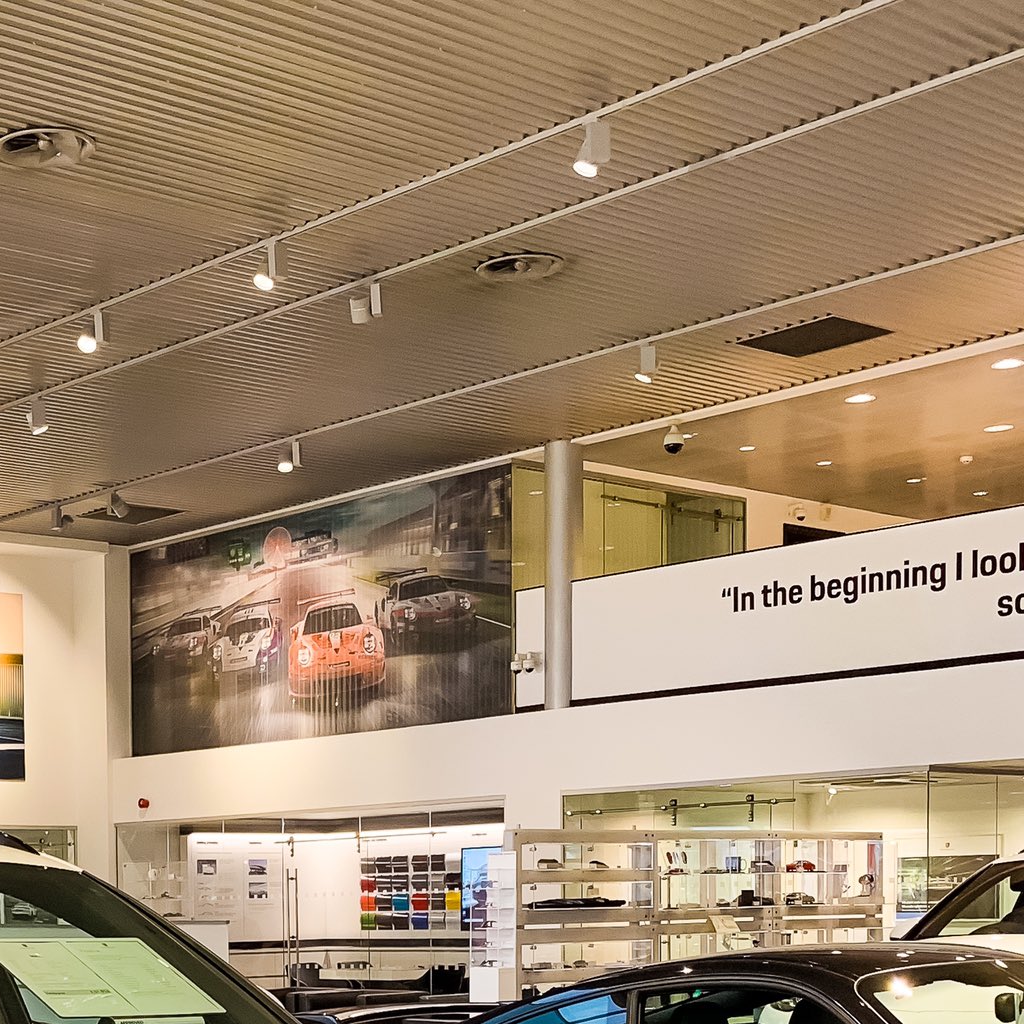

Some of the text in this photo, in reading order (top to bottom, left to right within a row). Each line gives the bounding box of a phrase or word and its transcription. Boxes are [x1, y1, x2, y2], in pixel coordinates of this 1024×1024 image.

[761, 579, 803, 608] the
[809, 559, 947, 603] beginning
[955, 552, 963, 581] I
[971, 542, 1024, 578] loo
